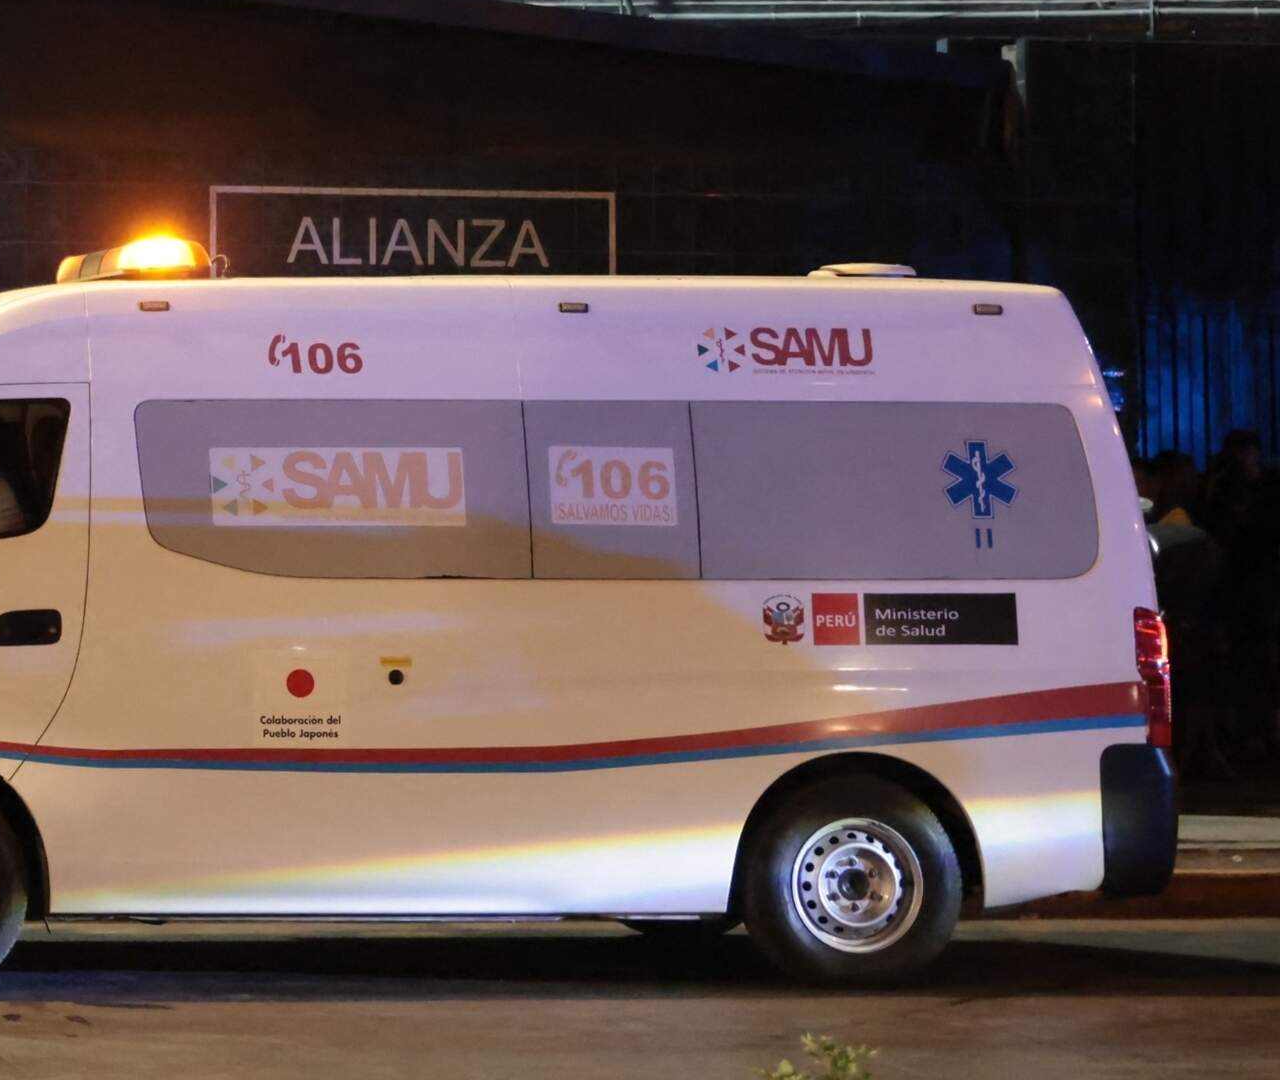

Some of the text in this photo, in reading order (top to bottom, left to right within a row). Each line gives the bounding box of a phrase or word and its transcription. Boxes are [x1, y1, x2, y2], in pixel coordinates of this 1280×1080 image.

[286, 216, 550, 268] ALIANZA
[282, 342, 363, 374] 106
[750, 327, 873, 367] SAMU
[281, 451, 463, 510] SAMU
[570, 459, 671, 500] 106
[815, 608, 960, 627] PERÚ Ministerio
[875, 625, 946, 637] de Salud
[260, 714, 342, 725] Colaboración del
[263, 727, 339, 740] Pueblo Japonés
